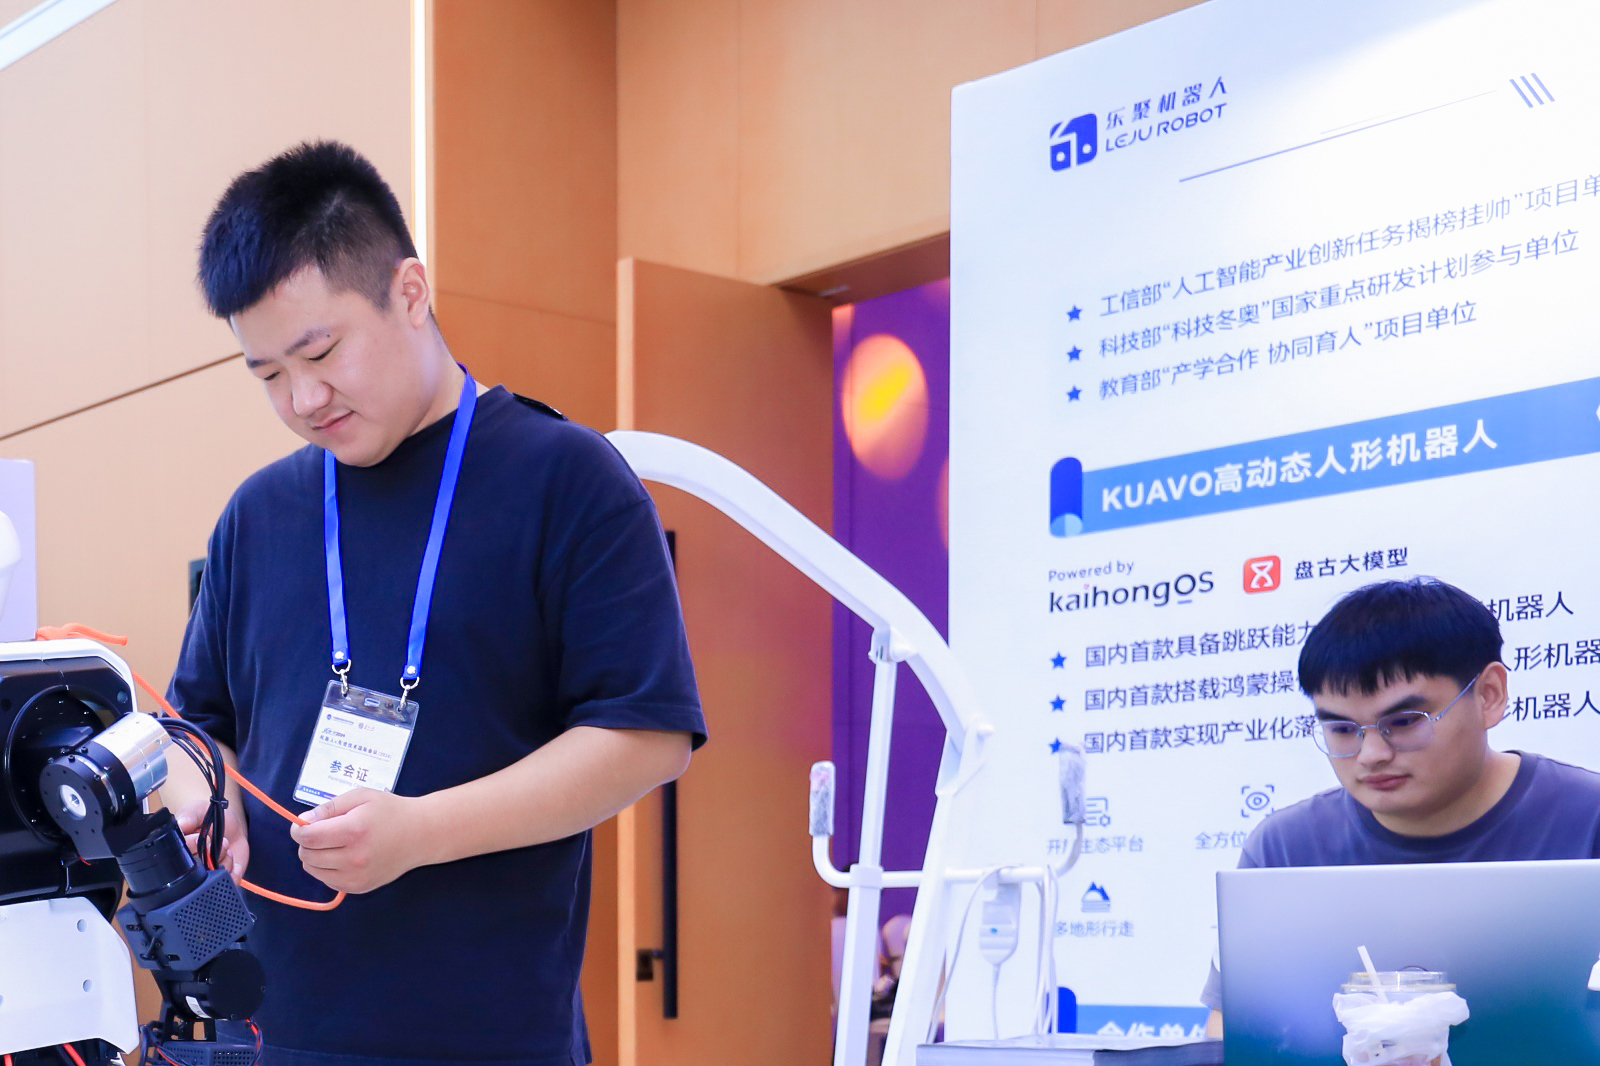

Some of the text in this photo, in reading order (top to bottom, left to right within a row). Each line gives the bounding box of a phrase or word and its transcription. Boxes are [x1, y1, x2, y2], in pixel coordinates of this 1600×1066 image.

[1106, 76, 1228, 130] 乐聚机器人
[1106, 103, 1228, 152] LEJU ROBOT
[1101, 420, 1498, 513] KUAVO高动态人形机器人
[1048, 559, 1134, 582] Powered by
[1294, 547, 1408, 580] 盘古大模型
[1049, 570, 1215, 613] kaihongOS
[1084, 669, 1302, 711] 国内首款搭载鸿蒙操
[329, 760, 370, 782] 参会证
